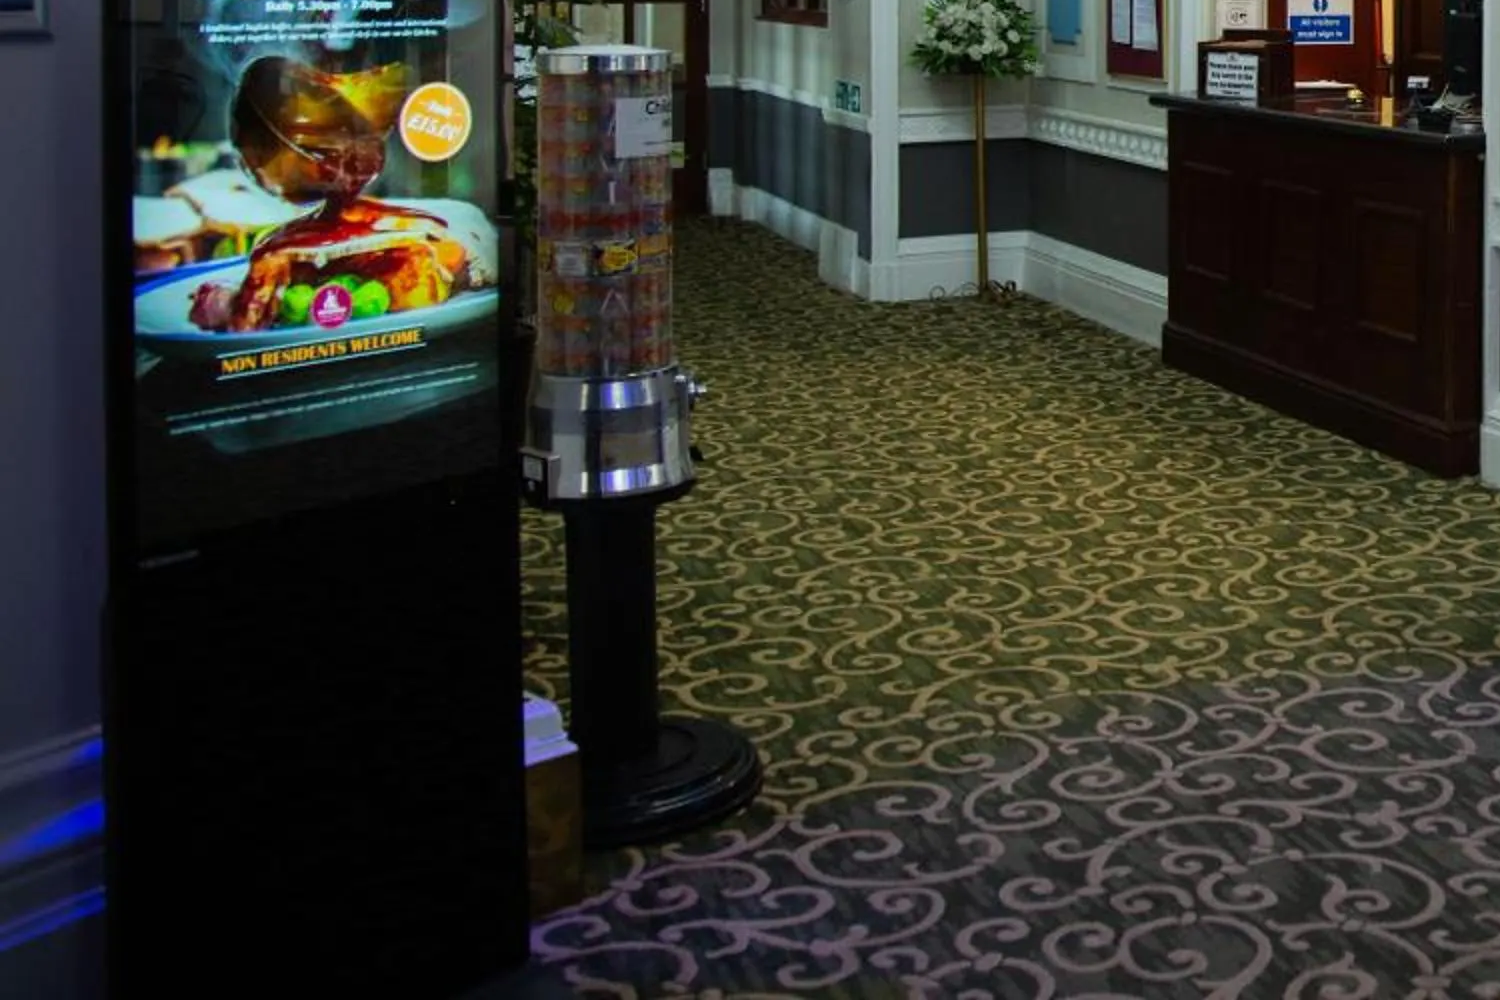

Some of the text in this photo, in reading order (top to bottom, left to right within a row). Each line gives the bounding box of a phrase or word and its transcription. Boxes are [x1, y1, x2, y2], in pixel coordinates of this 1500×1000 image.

[221, 328, 422, 374] NON RESIDENTS WELCOME
